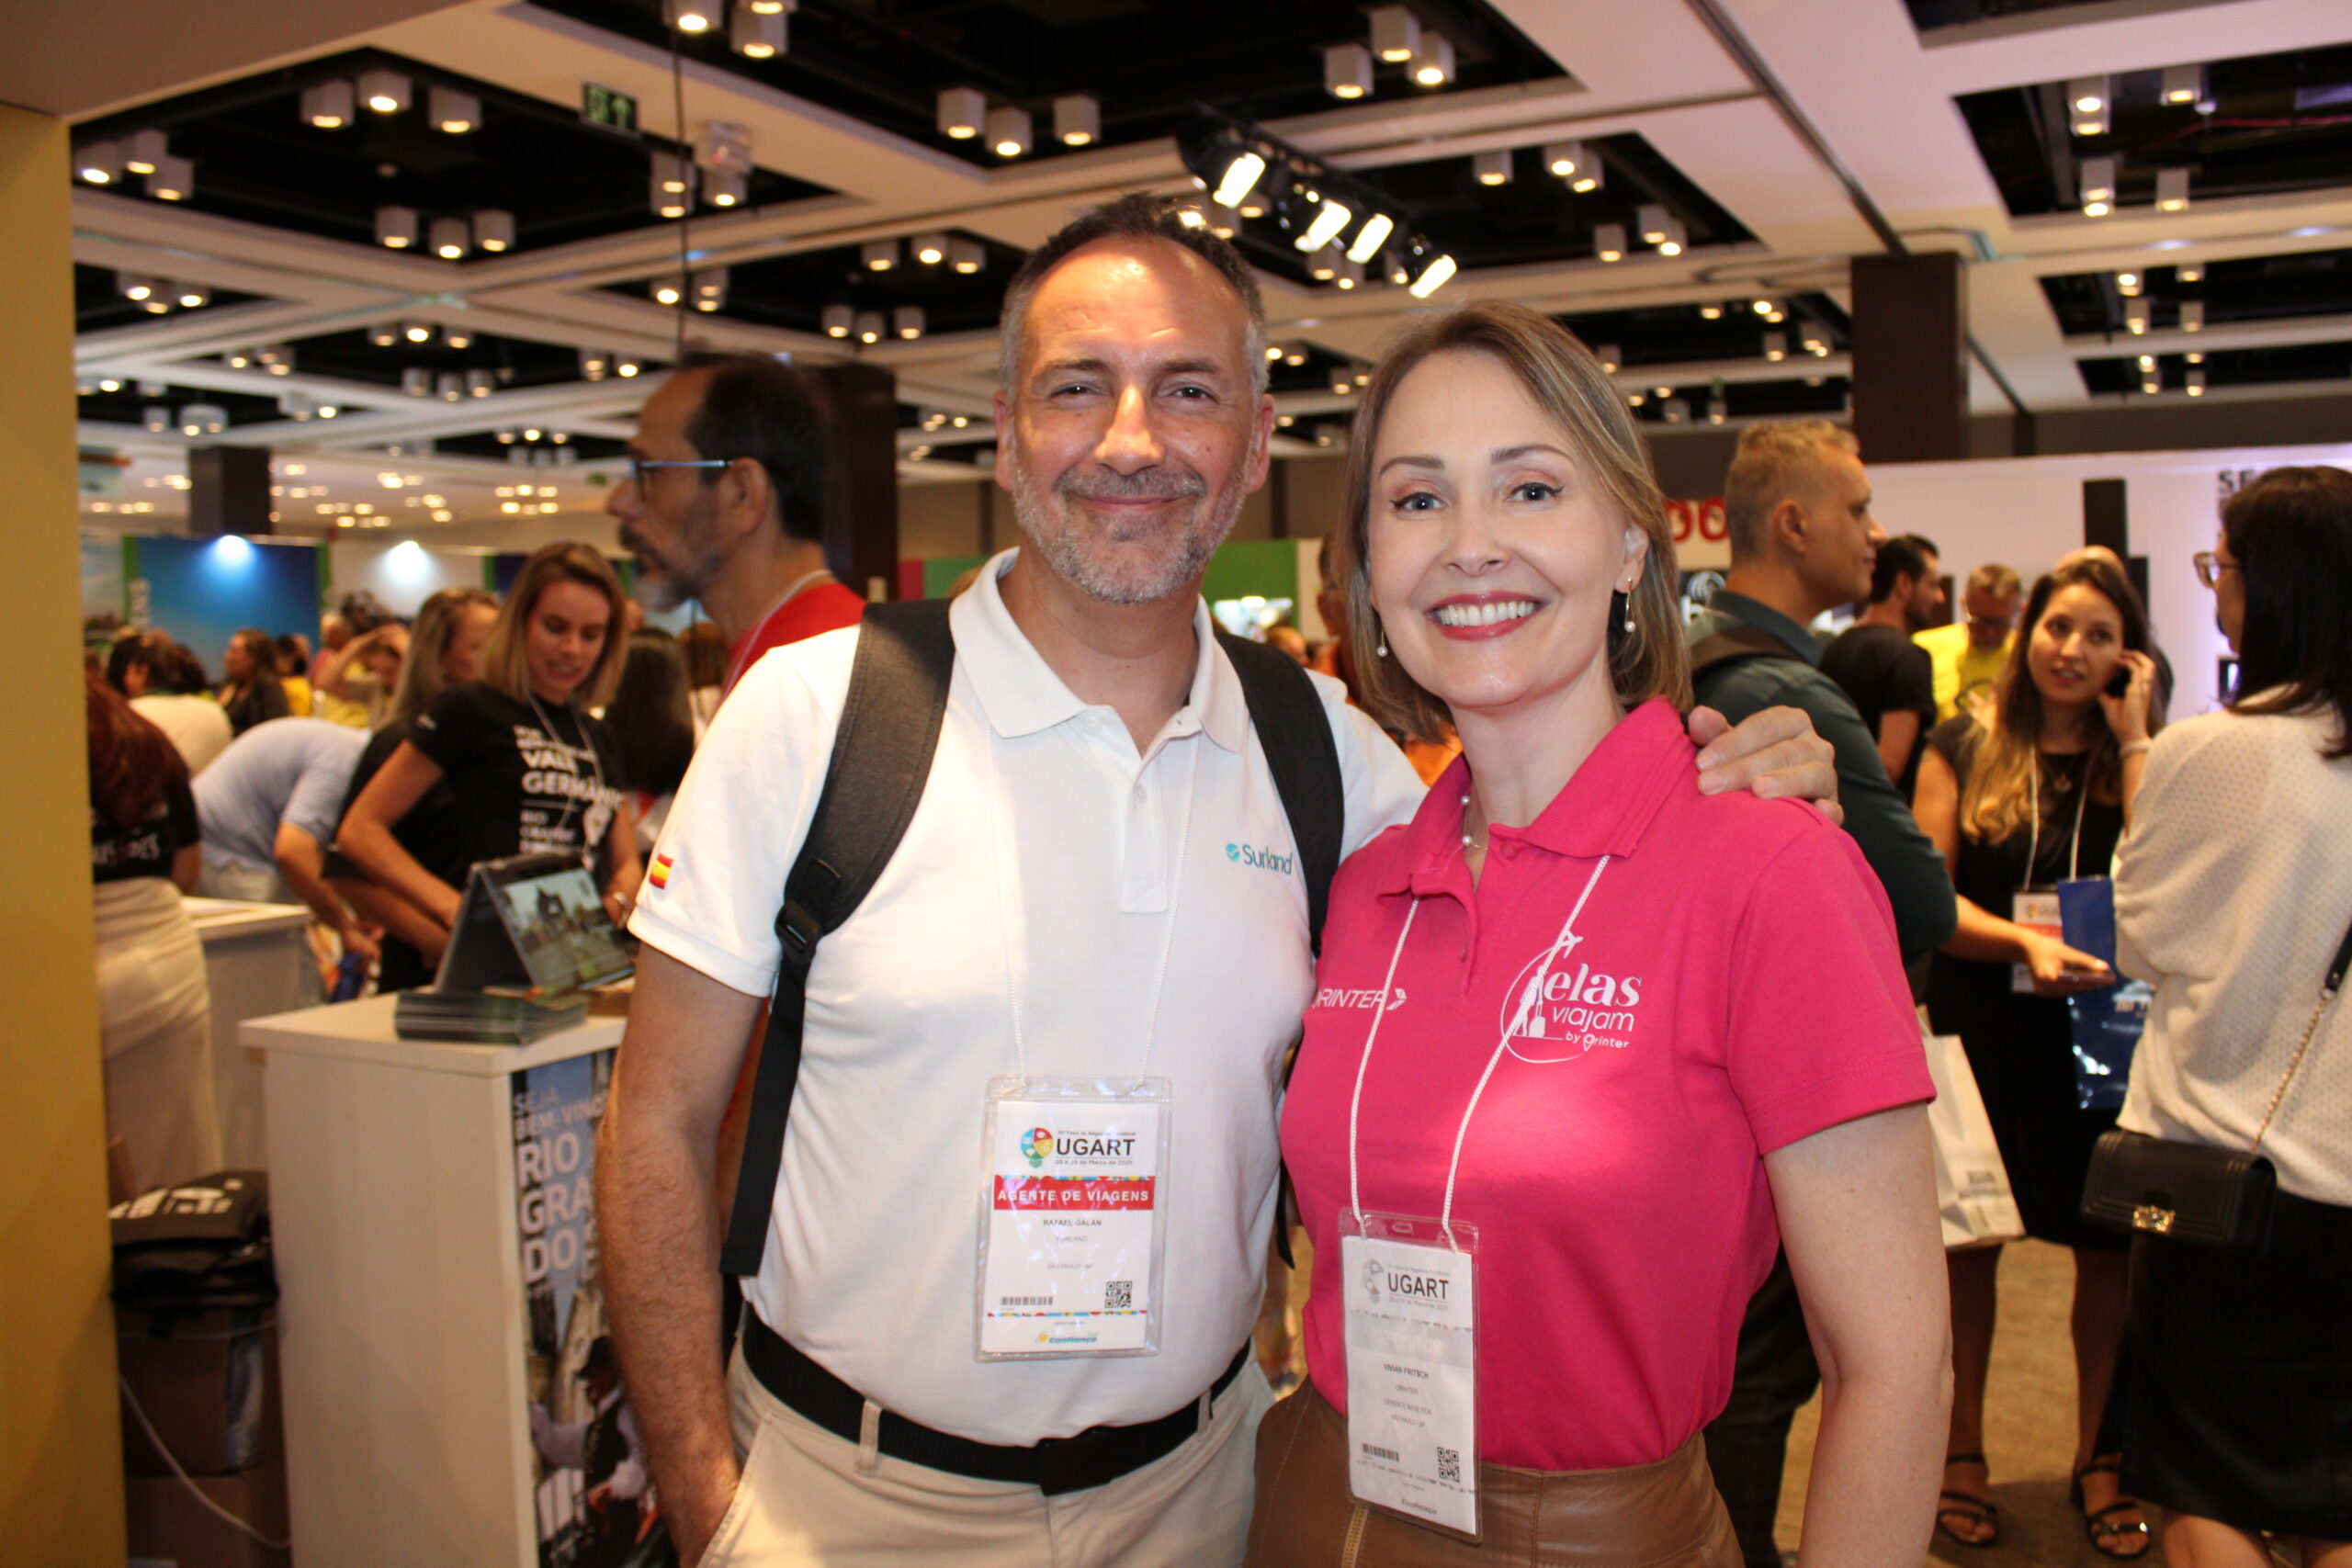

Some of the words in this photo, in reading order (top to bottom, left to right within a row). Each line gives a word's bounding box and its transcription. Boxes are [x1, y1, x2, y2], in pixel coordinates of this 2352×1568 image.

[1242, 843, 1293, 875] Surland
[1544, 963, 1642, 1007] elas
[1553, 1006, 1634, 1032] viajam
[1566, 1030, 1581, 1043] by
[517, 1132, 580, 1187] RIO
[1057, 1138, 1136, 1156] UGART
[998, 1190, 1056, 1201] AGENTE
[1062, 1190, 1080, 1201] DE
[1088, 1190, 1149, 1201] VIAGENS
[523, 1228, 578, 1284] DO
[1387, 1272, 1449, 1300] UGART
